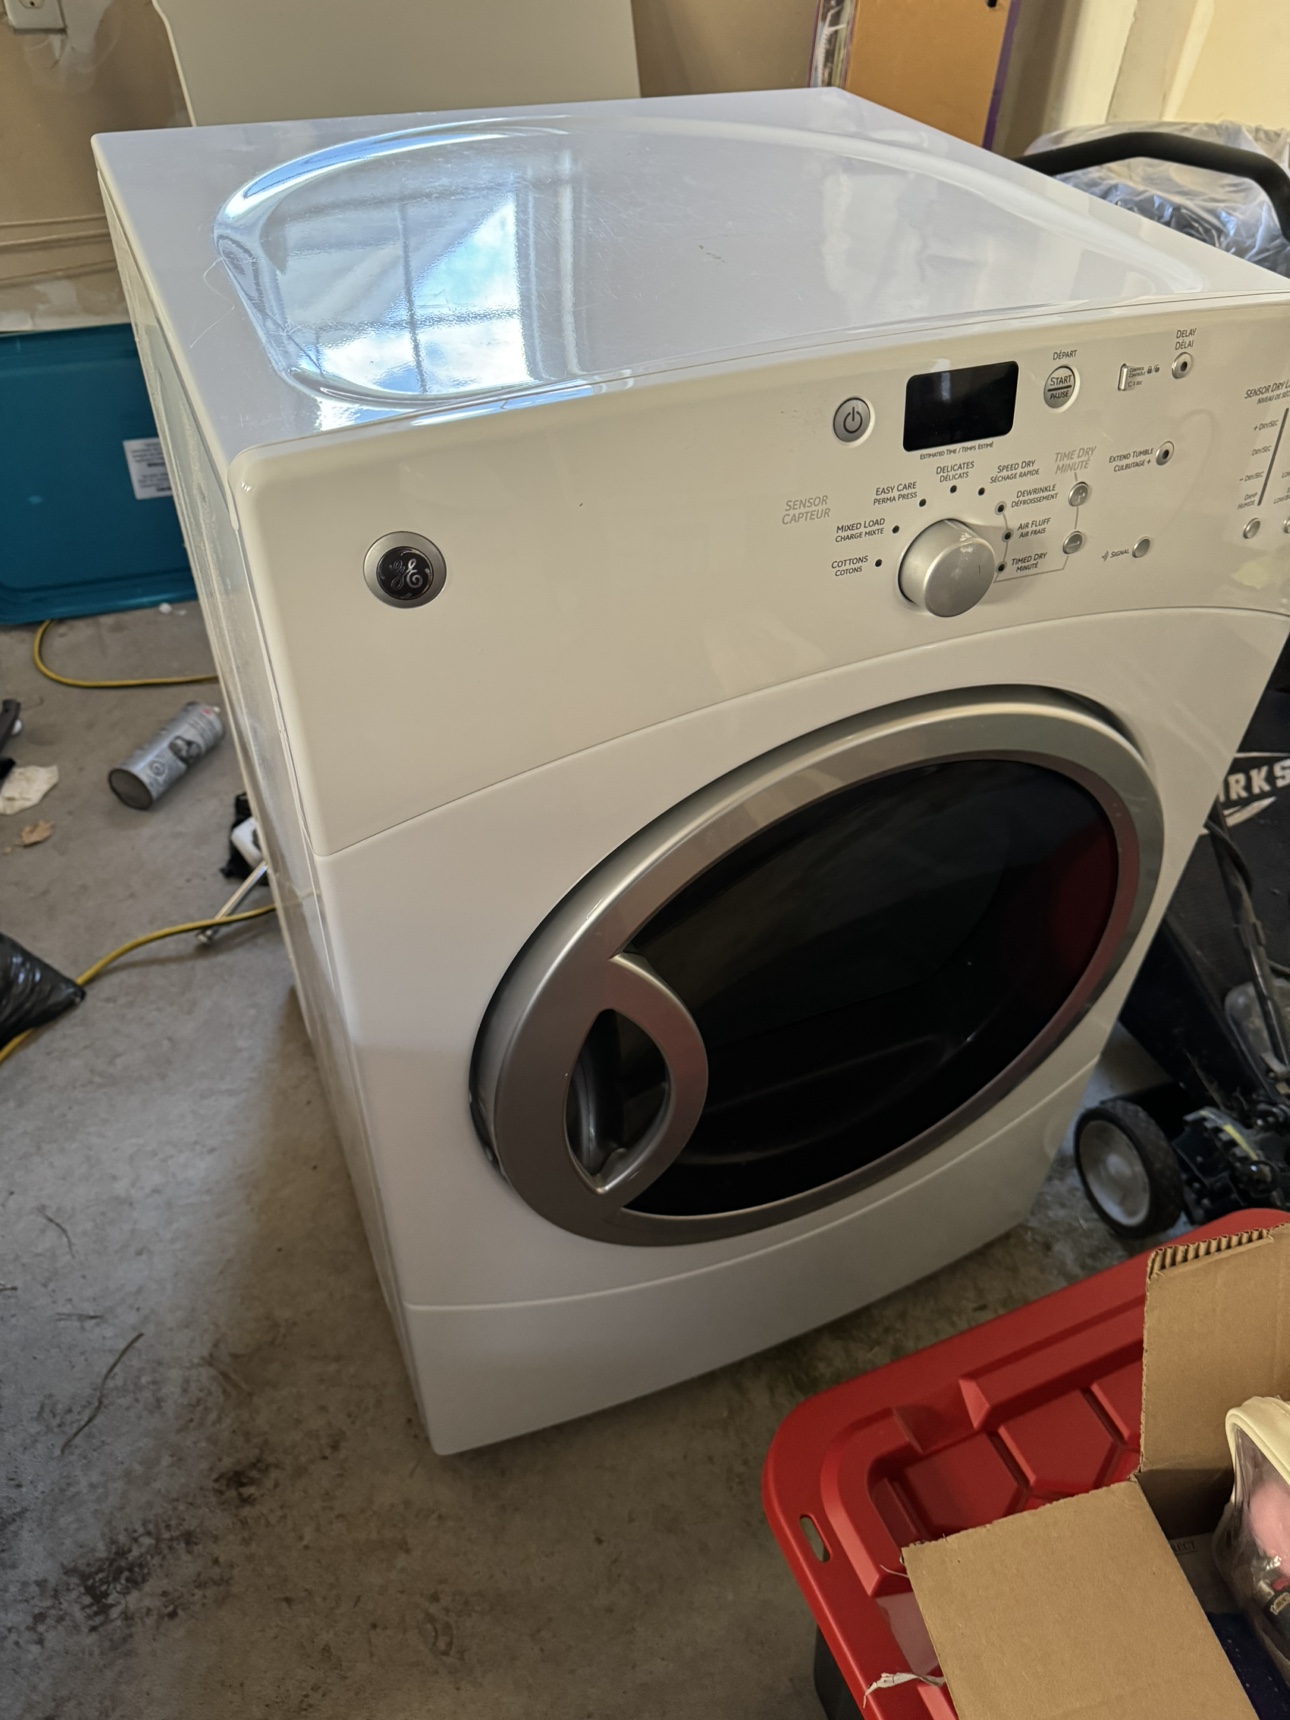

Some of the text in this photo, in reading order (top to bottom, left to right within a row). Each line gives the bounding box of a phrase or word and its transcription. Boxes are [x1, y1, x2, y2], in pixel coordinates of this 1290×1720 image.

[1176, 328, 1197, 339] DELAY
[1174, 339, 1194, 350] DÉLAI
[1052, 349, 1077, 361] DÉPART
[1050, 375, 1072, 386] START
[1050, 390, 1069, 400] PAUSE
[1244, 385, 1271, 399] SENSOR
[1055, 446, 1097, 463] TIME DRY
[1109, 448, 1154, 463] EXTEND TUMBLE
[936, 461, 975, 475] DELICATES
[997, 460, 1036, 474] SPEED DRY
[1055, 457, 1091, 475] MINUTÉ
[1113, 459, 1146, 472] CULBUTAGE
[939, 471, 969, 483] DÉLICATS
[990, 468, 1040, 484] SÉCHAGE RAPIDE
[875, 481, 917, 496] EASY CARE
[1016, 484, 1057, 499] DEWRINKLE
[785, 495, 829, 512] SENSOR
[873, 491, 918, 506] PERMA PRESS
[1011, 492, 1059, 508] DÉFROISSEMENT
[781, 507, 831, 525] CAPTEUR
[836, 518, 886, 534] MIXED LOAD
[1017, 517, 1052, 531] AIR FLUFF
[835, 527, 885, 543] CHARGE MIXTE
[1019, 527, 1047, 539] AIR FRAIS
[1011, 552, 1048, 566] TIMED DRY
[1110, 549, 1130, 559] SIGNAL
[831, 555, 869, 569] COTTONS
[1016, 562, 1039, 573] MINUTÉ
[834, 566, 863, 577] COTONS
[1218, 758, 1290, 803] RKS
